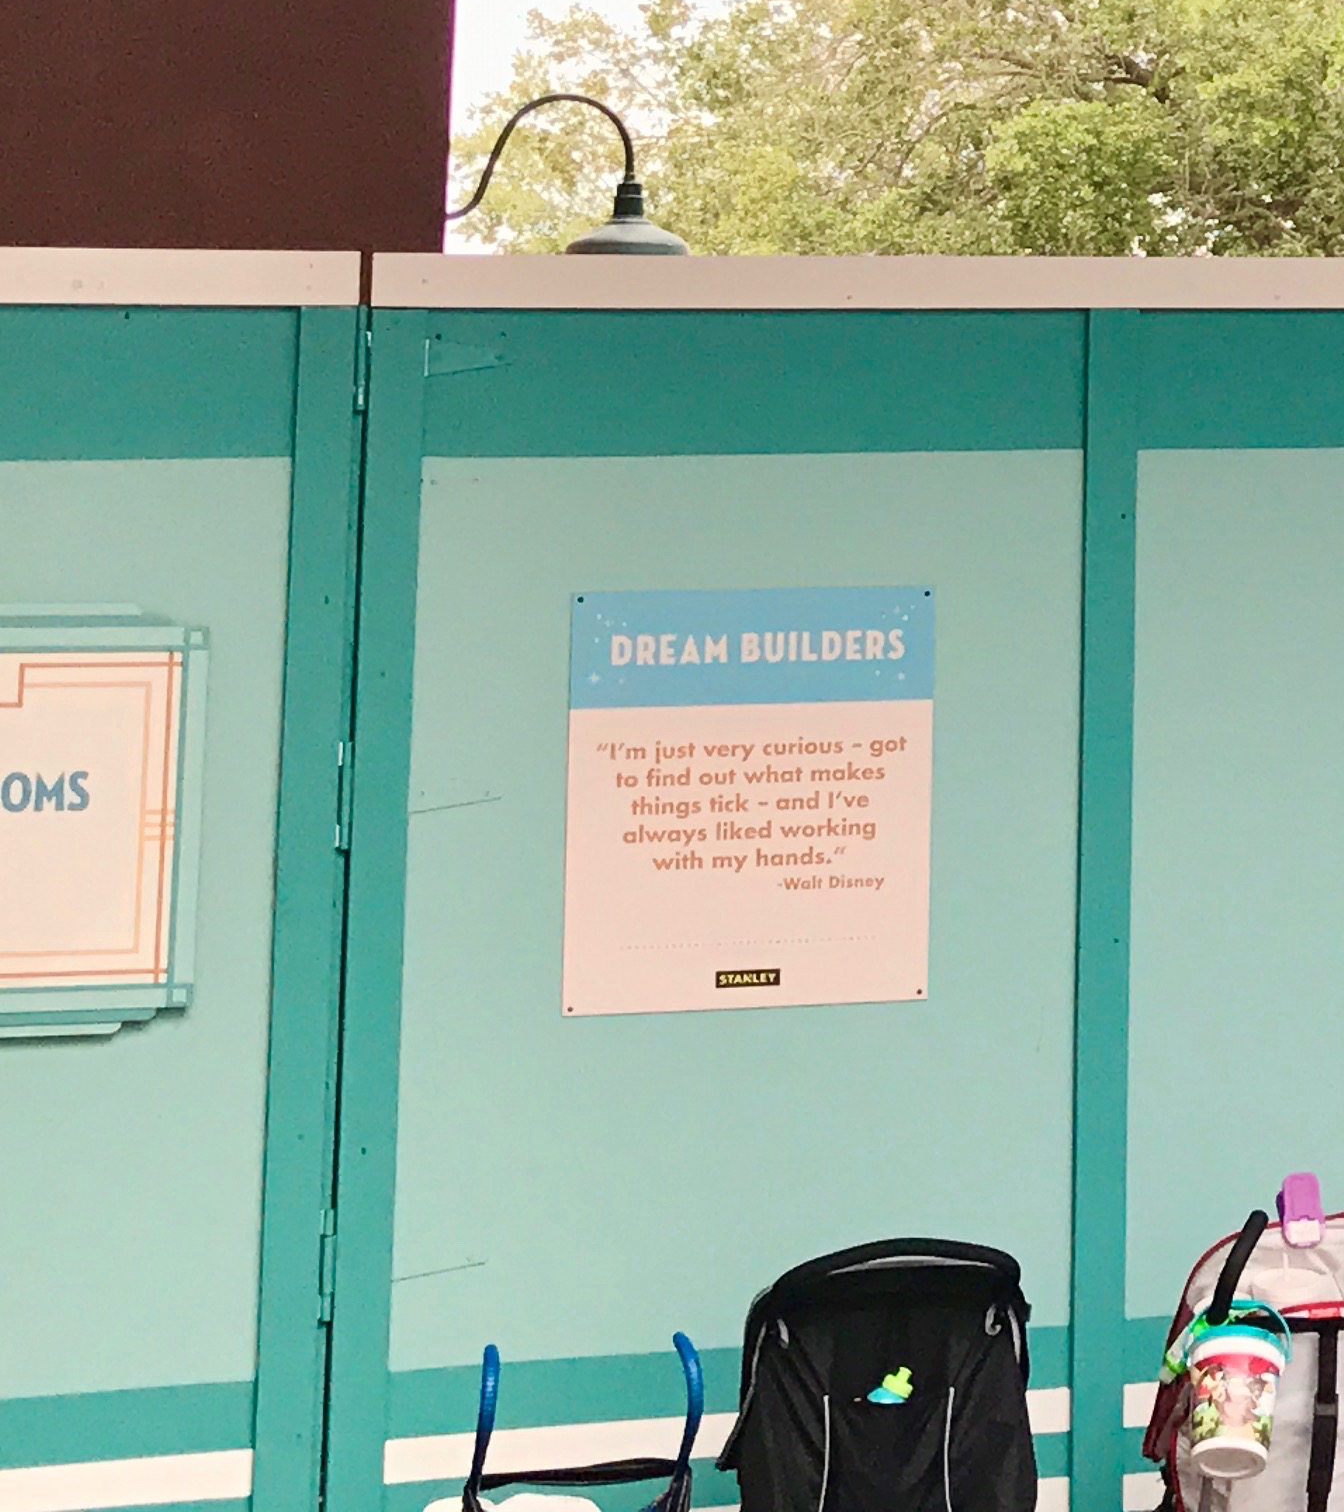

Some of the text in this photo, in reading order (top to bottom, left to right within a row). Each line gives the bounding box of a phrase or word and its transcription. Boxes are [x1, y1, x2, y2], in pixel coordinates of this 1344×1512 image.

[610, 629, 905, 666] DREAM BUILDERS
[597, 743, 646, 760] "I'm
[655, 740, 695, 764] just
[704, 744, 755, 762] very
[763, 736, 843, 756] curious
[870, 736, 907, 757] got
[617, 762, 885, 788] to find out what makes
[1, 771, 90, 812] OMS
[631, 796, 701, 819] things
[710, 793, 749, 812] tick
[776, 791, 819, 810] and
[829, 791, 869, 808] I've
[623, 818, 876, 846] always liked working
[652, 846, 845, 873] with my hands."
[778, 875, 884, 890] -Walt Disney
[718, 972, 776, 985] STANLEY
